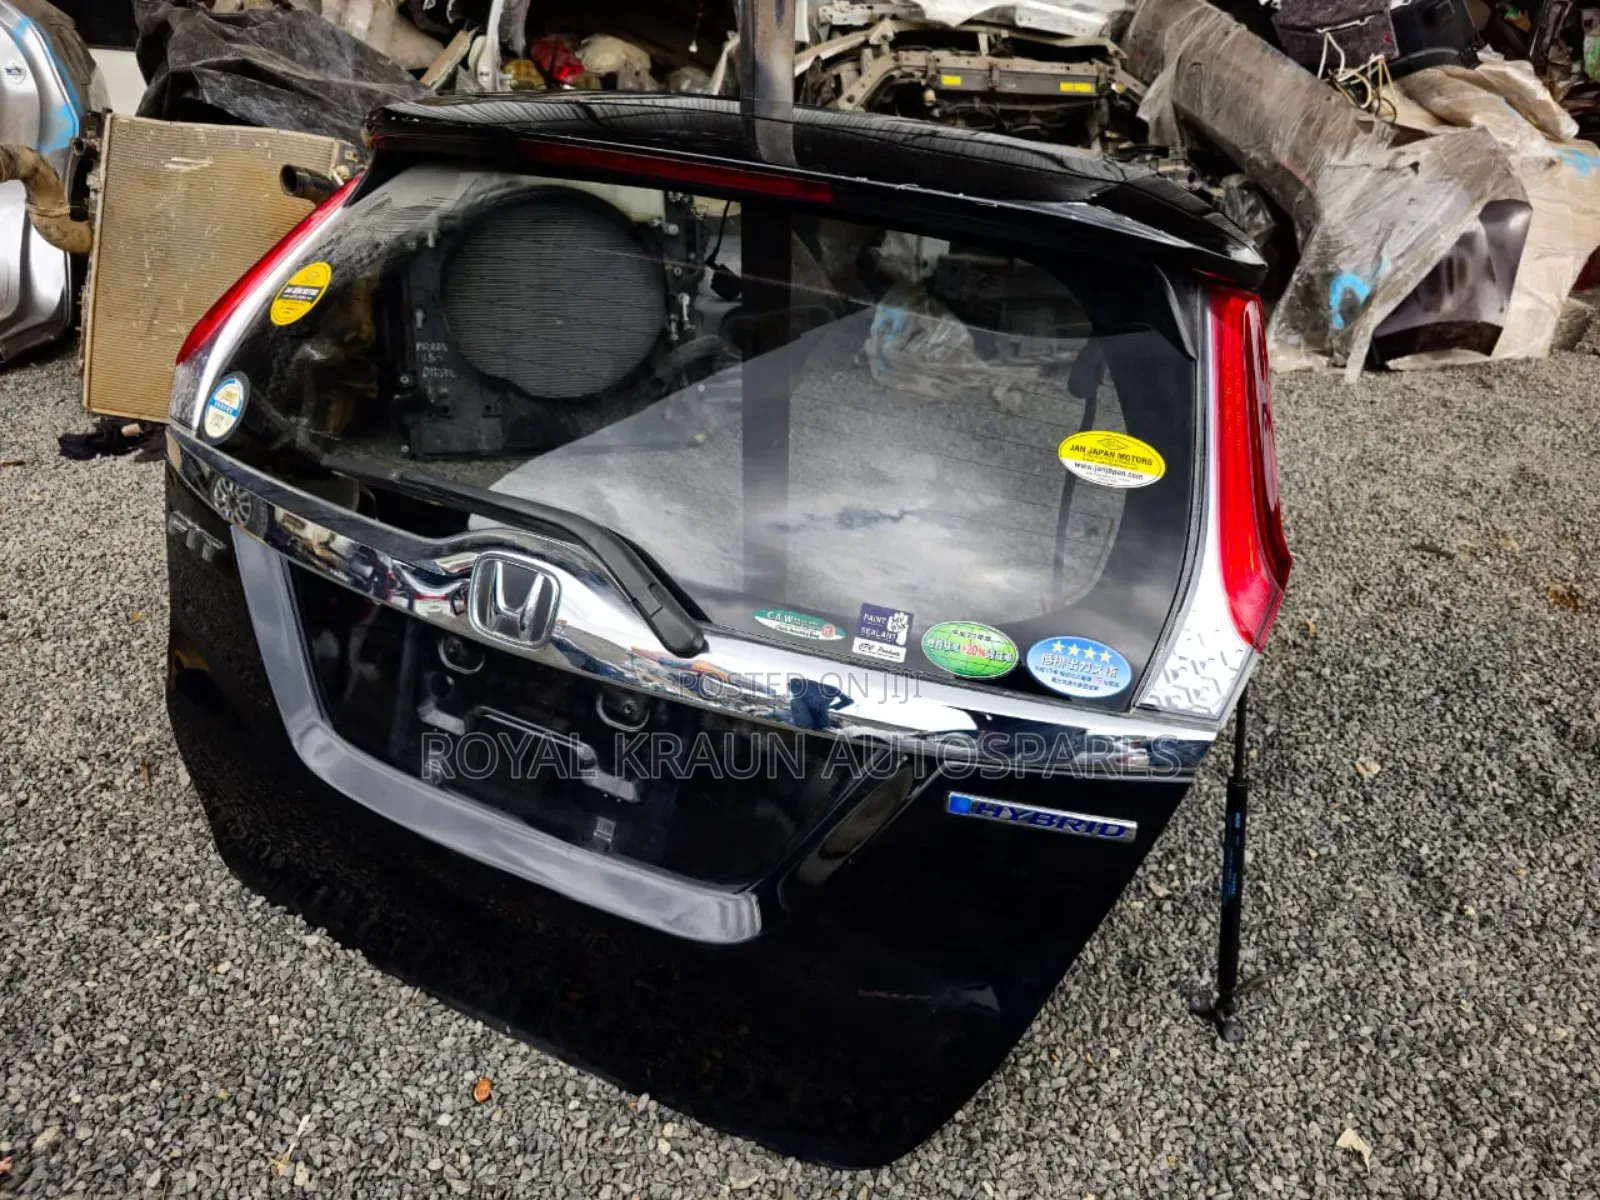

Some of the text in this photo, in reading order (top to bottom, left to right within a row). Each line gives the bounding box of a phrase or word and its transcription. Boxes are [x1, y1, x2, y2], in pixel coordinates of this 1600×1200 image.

[1069, 444, 1086, 452] JAN
[1088, 447, 1115, 458] JAPAN
[1117, 453, 1153, 466] MOTORS
[863, 613, 887, 625] PAINT
[860, 626, 898, 642] SEALANT
[974, 801, 1128, 838] HYBRID
